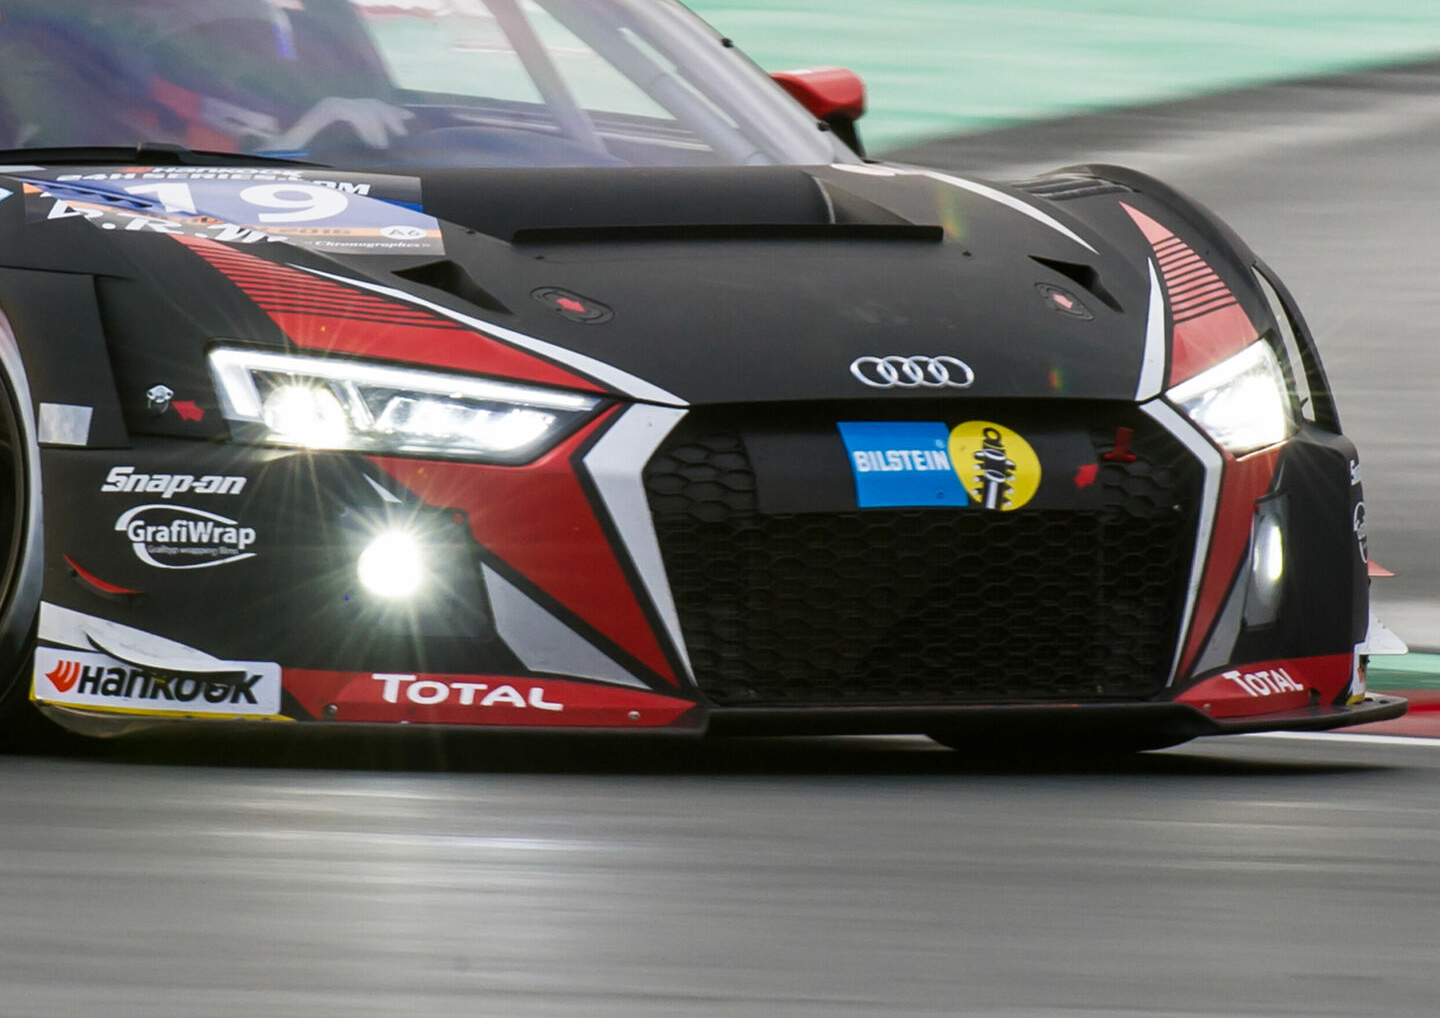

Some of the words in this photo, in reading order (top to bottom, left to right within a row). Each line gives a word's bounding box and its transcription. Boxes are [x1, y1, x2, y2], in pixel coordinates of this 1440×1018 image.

[124, 182, 349, 223] 19
[853, 450, 951, 472] BILSTEIN
[100, 466, 248, 498] Snap-on
[127, 519, 257, 549] GrafiWrap
[372, 673, 564, 711] TOTAL
[1222, 667, 1304, 697] TOTAL
